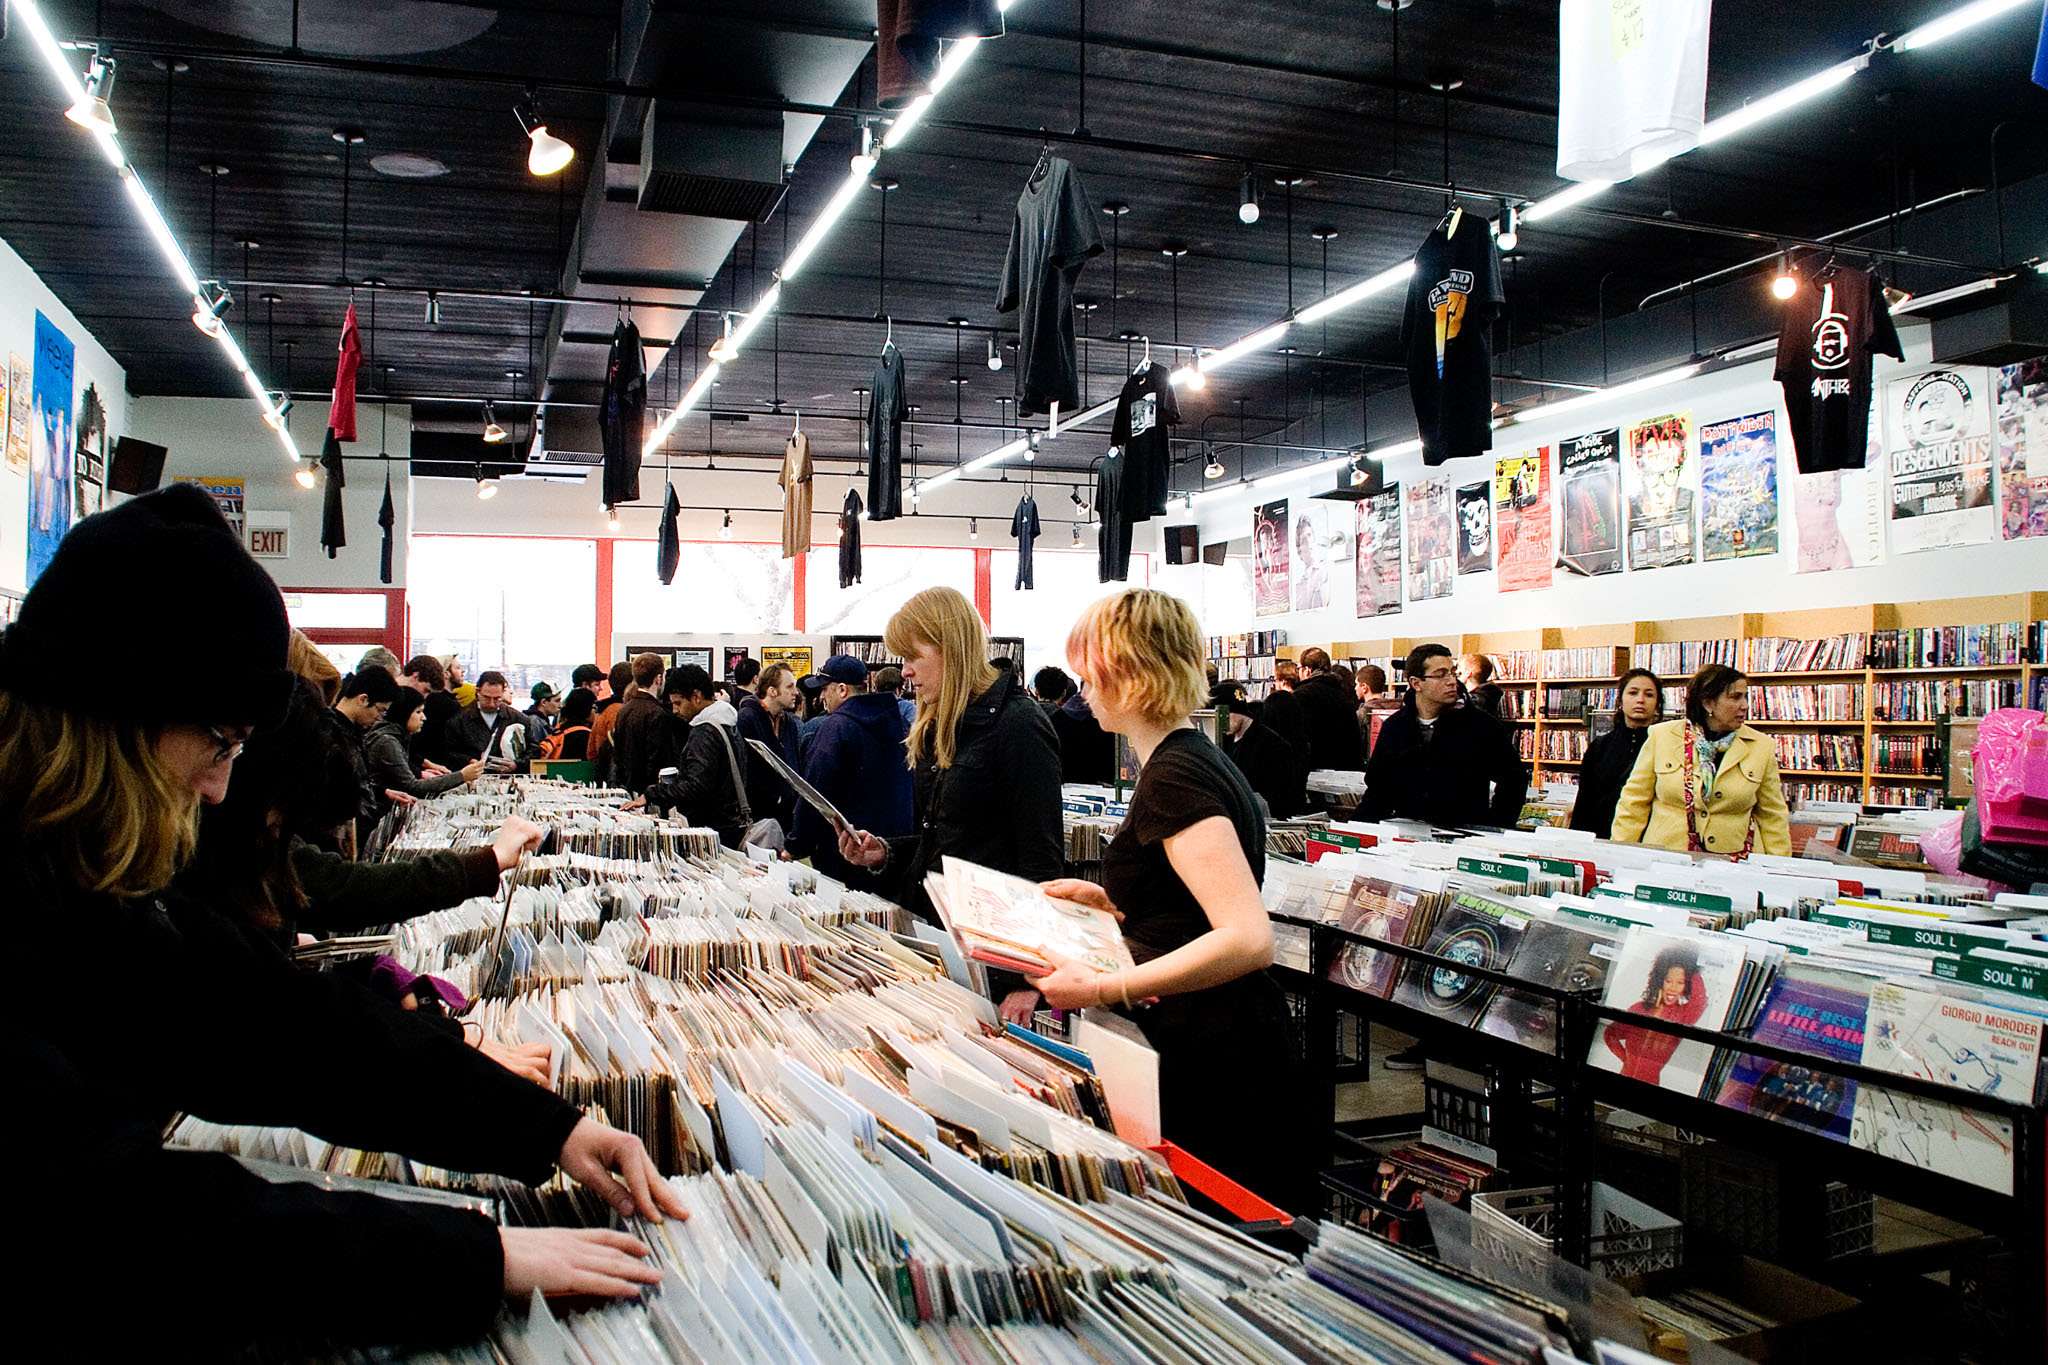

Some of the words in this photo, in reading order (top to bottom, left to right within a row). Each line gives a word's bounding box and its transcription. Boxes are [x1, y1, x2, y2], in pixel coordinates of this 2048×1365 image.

[1942, 371, 1968, 397] NATION
[1892, 437, 1990, 475] DESCENDENTS
[251, 531, 284, 553] EXIT
[1480, 862, 1495, 872] SOUL
[1496, 864, 1503, 873] C
[1667, 890, 1688, 902] SOUL
[1689, 894, 1697, 903] H
[1914, 931, 1945, 946] SOUL
[1950, 935, 1958, 948] L
[1982, 968, 2016, 987] SOUL
[2021, 976, 2034, 990] M
[1768, 1010, 1818, 1032] LITTLE
[1820, 1010, 1859, 1030] BEST
[1941, 1004, 1982, 1024] GIORGIO
[1984, 1014, 2038, 1037] MORODER
[1991, 1034, 2017, 1049] REACH
[2019, 1042, 2036, 1053] OUT
